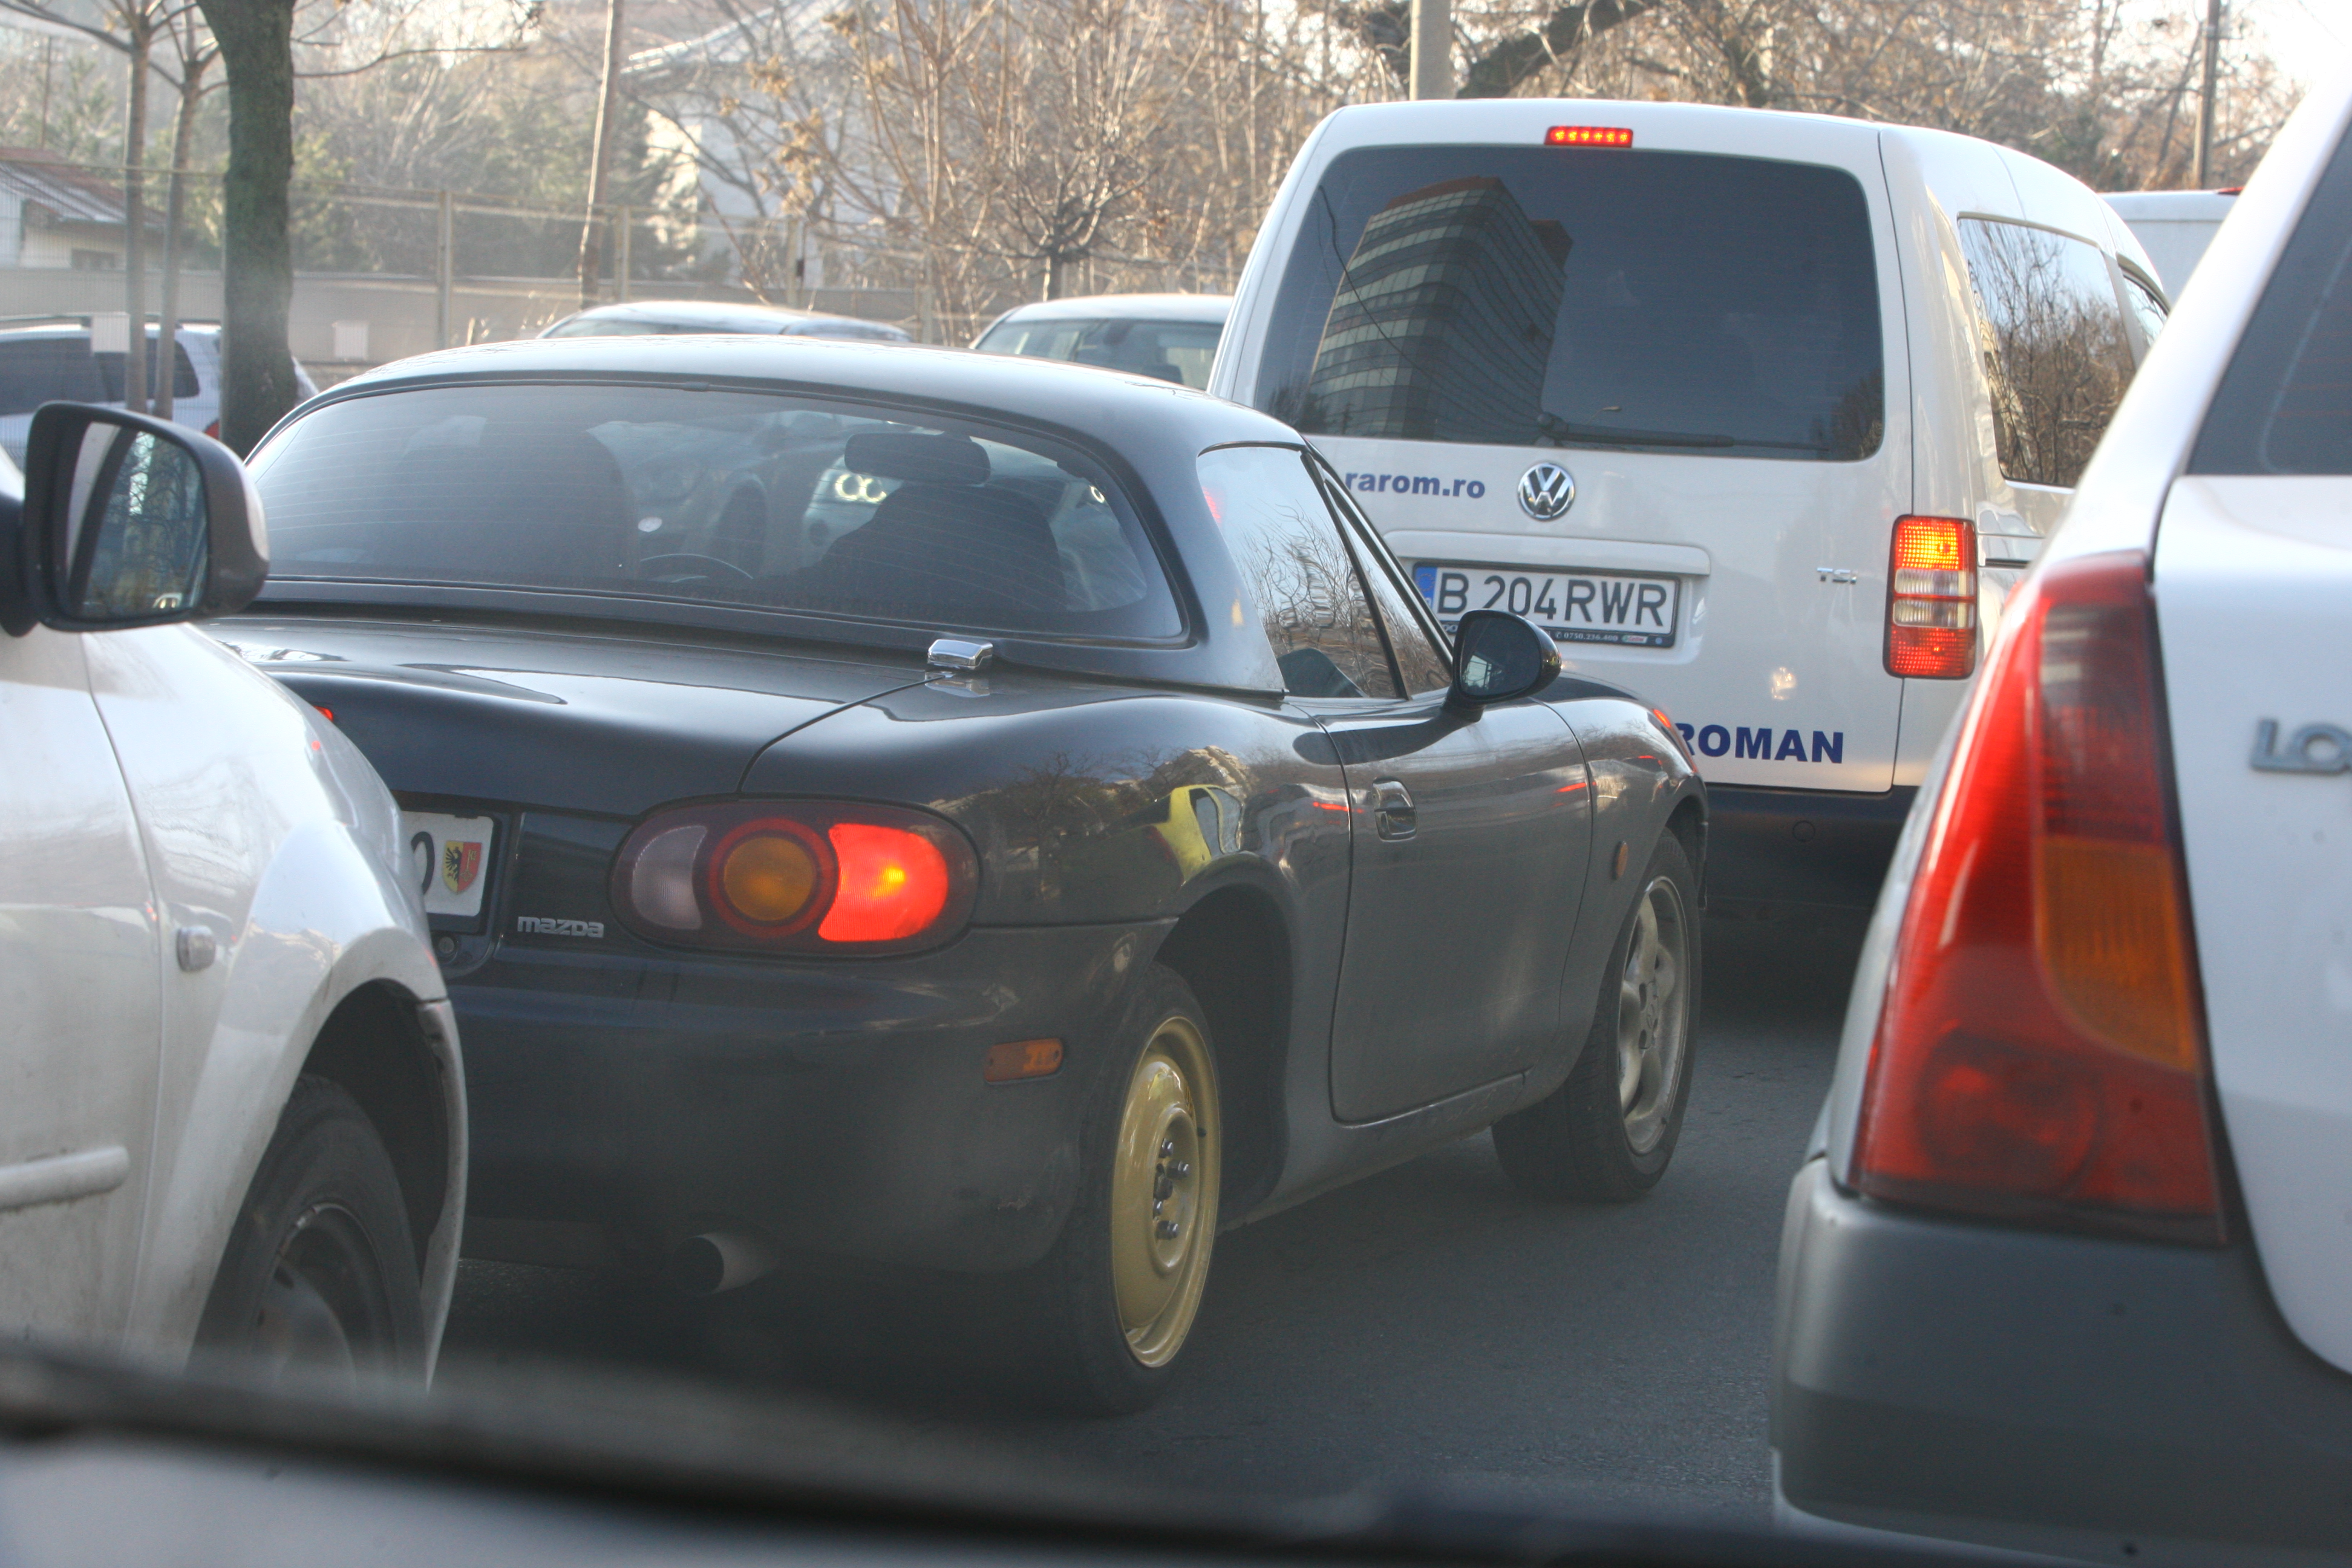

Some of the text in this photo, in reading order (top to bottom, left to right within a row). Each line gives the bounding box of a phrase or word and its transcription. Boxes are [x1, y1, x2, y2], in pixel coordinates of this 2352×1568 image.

[1344, 472, 1485, 498] rarom.ro
[1438, 572, 1469, 614] B
[1674, 722, 1843, 764] ROMAN
